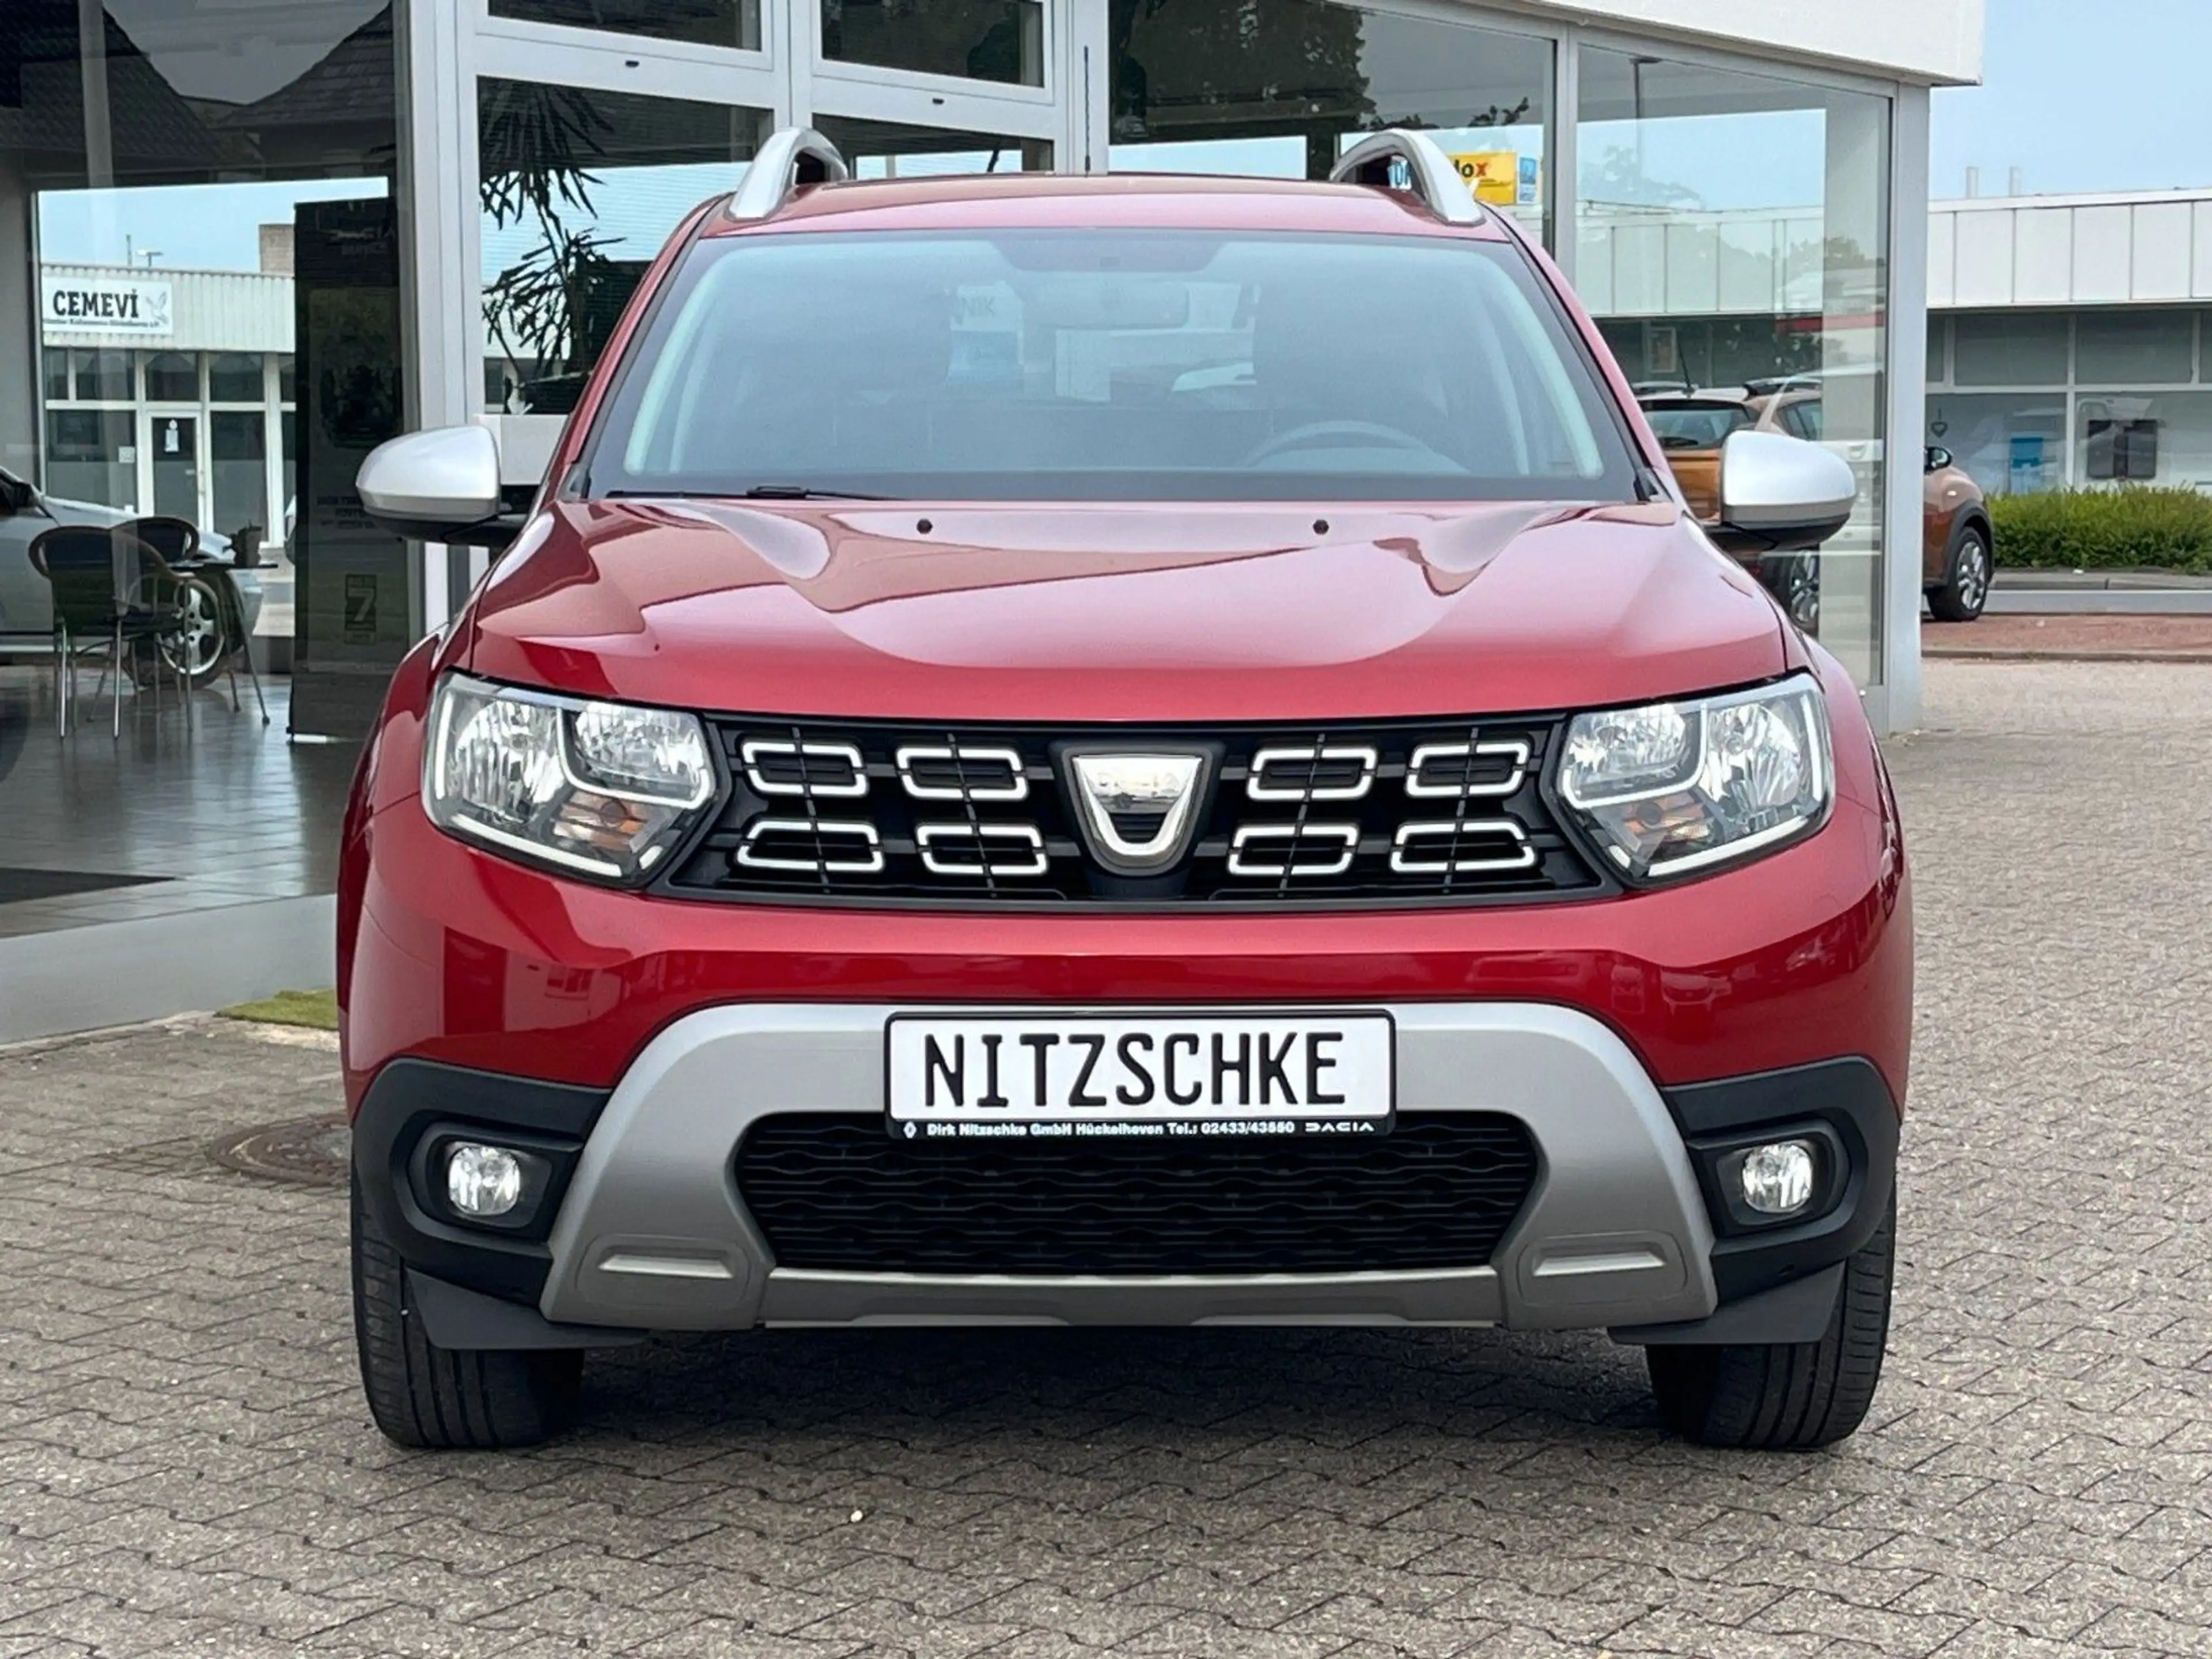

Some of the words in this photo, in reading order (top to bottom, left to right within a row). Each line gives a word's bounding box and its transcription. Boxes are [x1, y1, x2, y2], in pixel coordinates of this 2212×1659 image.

[53, 289, 139, 318] CEMEVİ
[924, 1032, 1346, 1108] NITZSCHKE
[927, 1123, 956, 1137] Dirk
[959, 1123, 1027, 1137] Nitzschke
[1029, 1122, 1073, 1136] GmbH
[1075, 1121, 1164, 1136] Hückelhoven
[1305, 1121, 1374, 1133] DACIA
